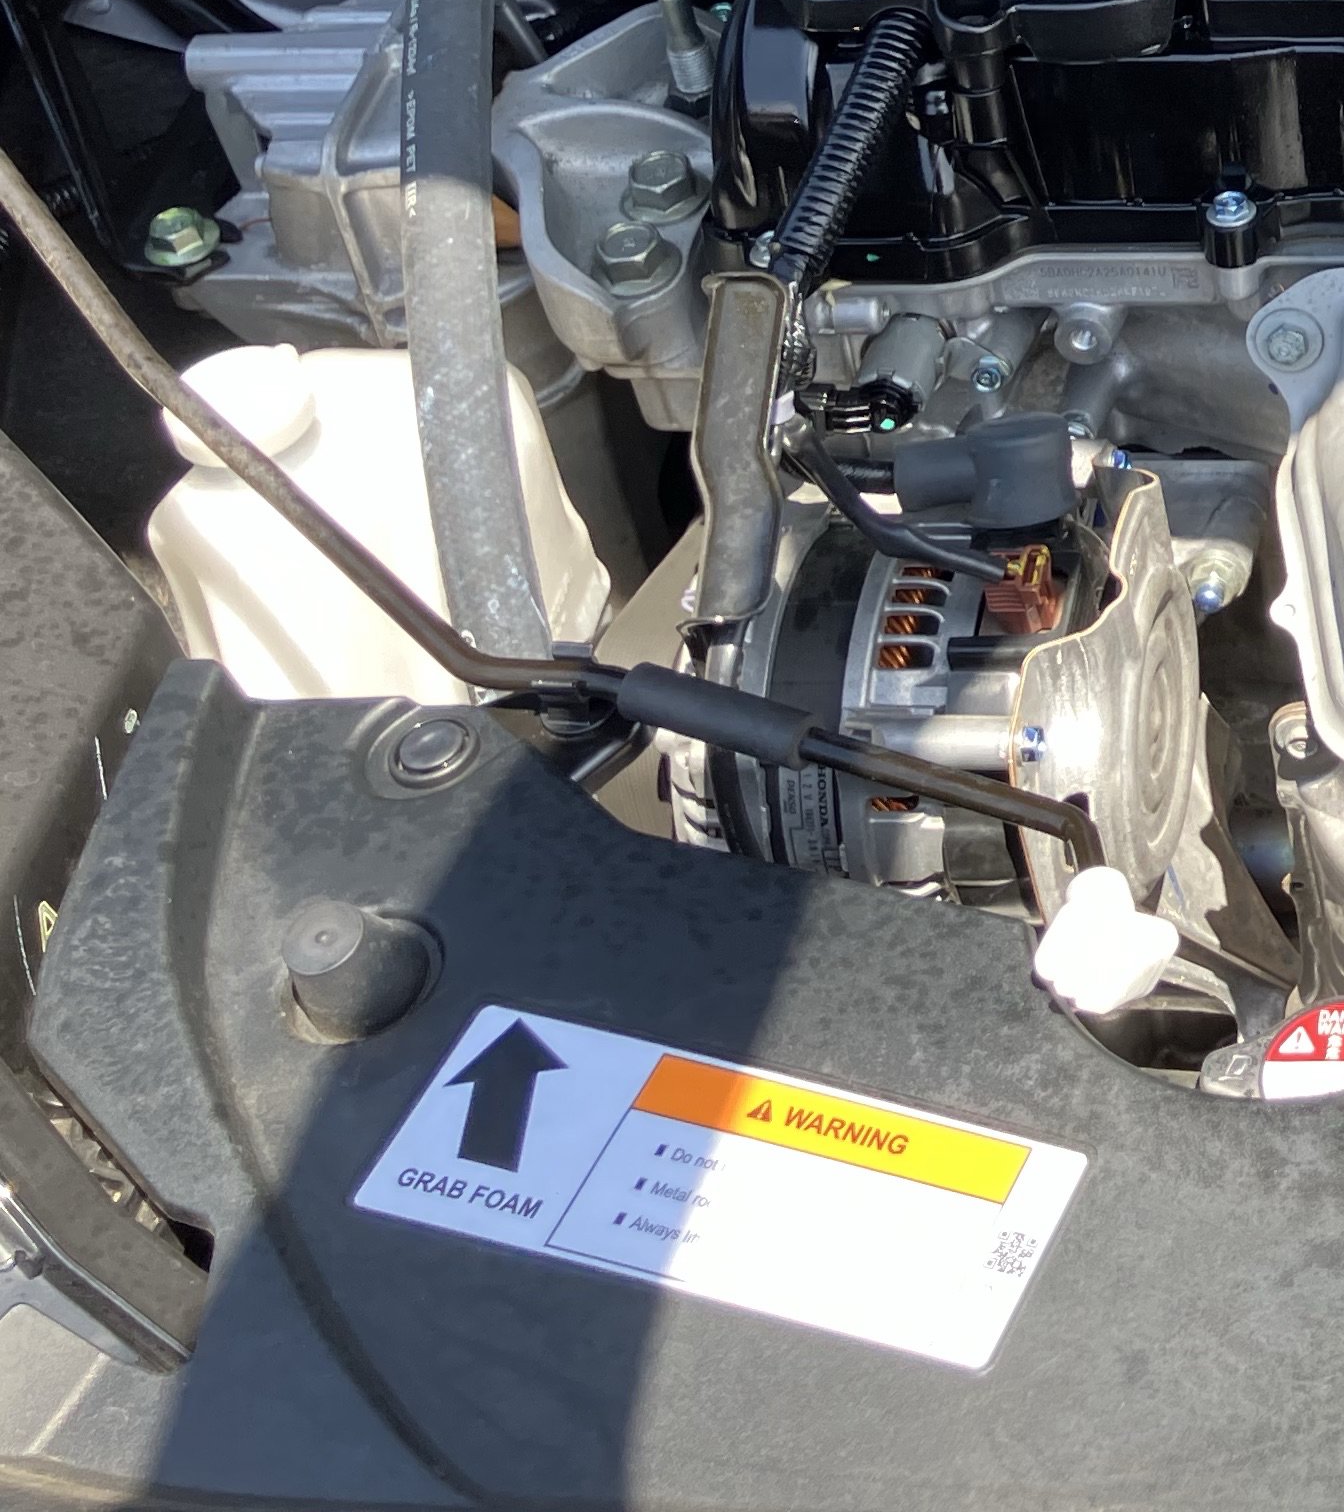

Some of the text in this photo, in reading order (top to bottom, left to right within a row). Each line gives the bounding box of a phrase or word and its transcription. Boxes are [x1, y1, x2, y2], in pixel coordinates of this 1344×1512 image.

[786, 779, 797, 815] DENSO
[817, 764, 829, 827] HONDA
[784, 1106, 910, 1156] WARNING
[670, 1147, 719, 1172] Do not
[397, 1167, 544, 1220] GRAB FOAM
[650, 1180, 691, 1205] Metal
[629, 1216, 680, 1242] Always
